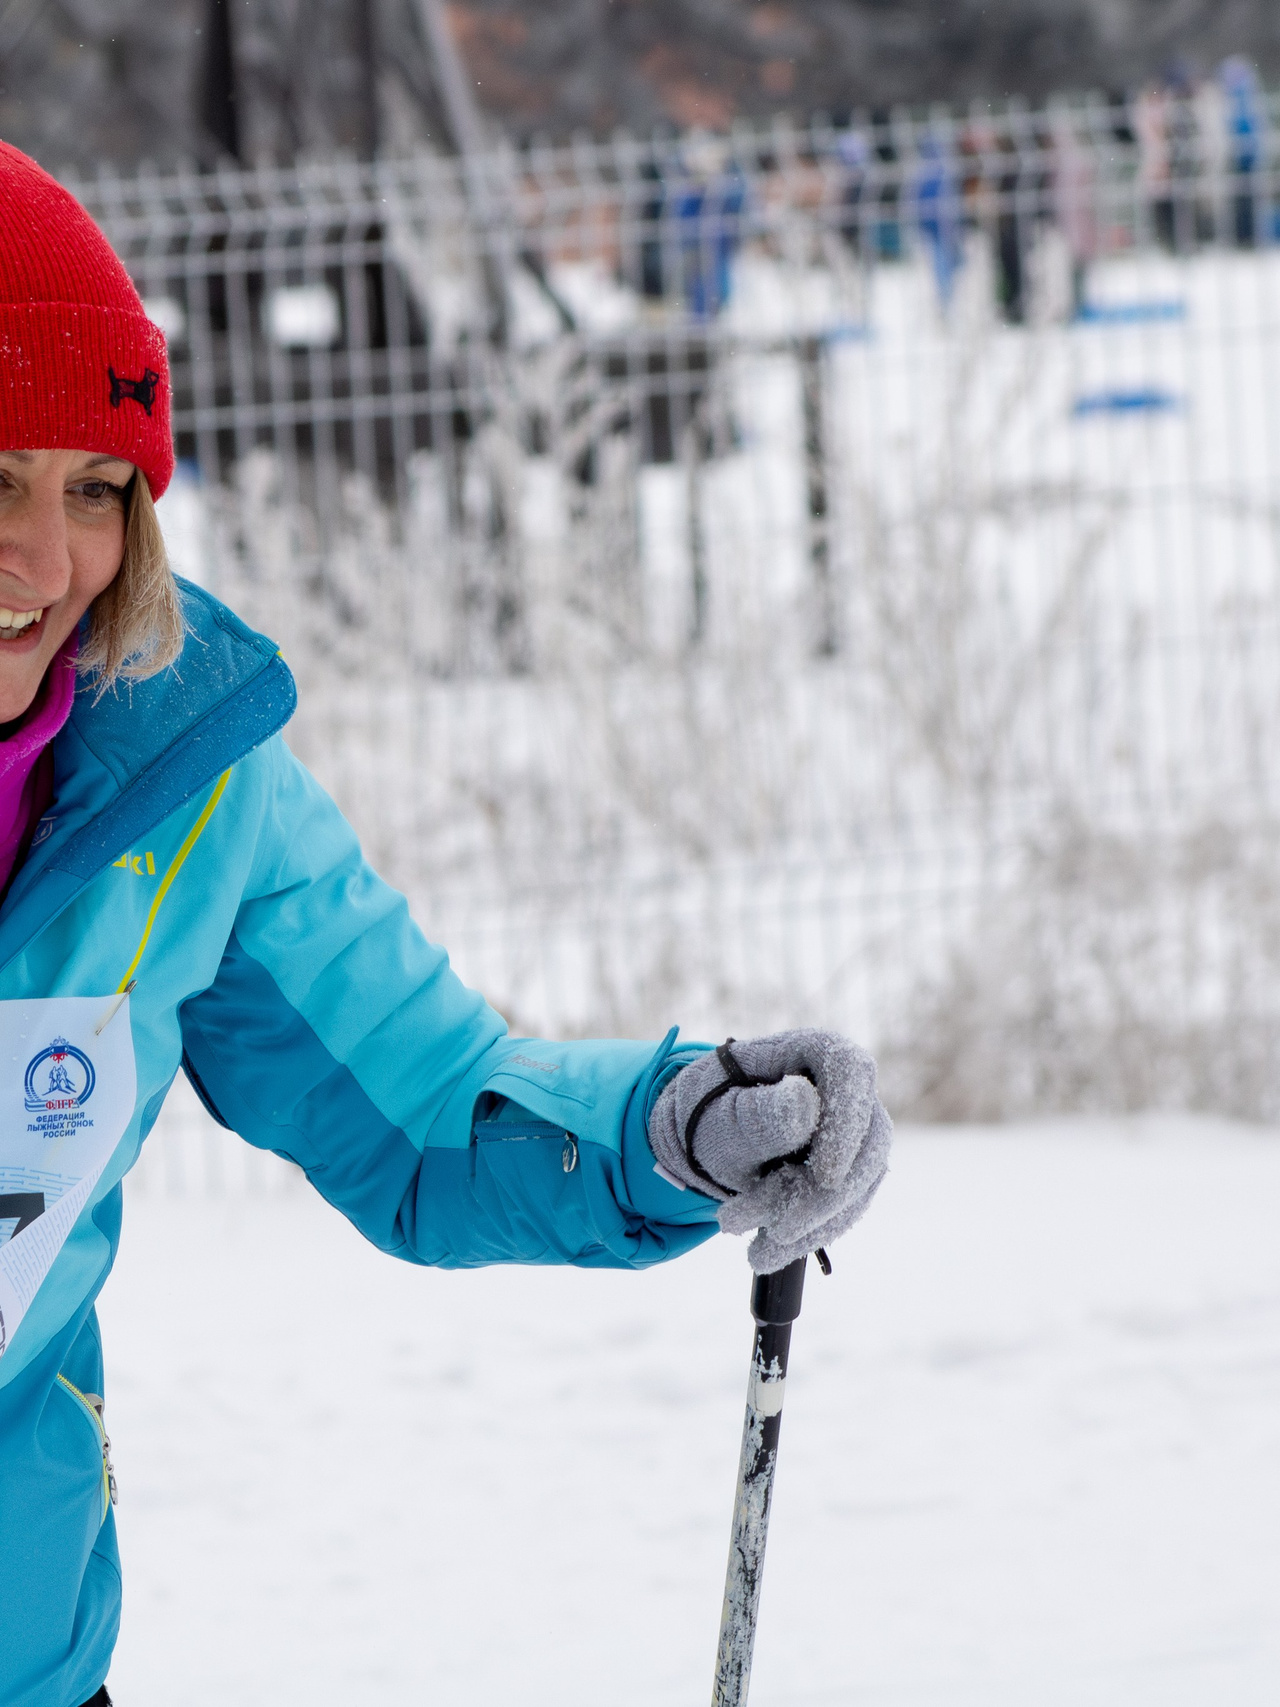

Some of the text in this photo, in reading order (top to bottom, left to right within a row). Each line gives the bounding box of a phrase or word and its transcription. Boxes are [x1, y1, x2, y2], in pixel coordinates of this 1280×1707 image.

[35, 1111, 85, 1123] ФЕДЕРАЦИЯ
[26, 1119, 94, 1132] ЛЫЖНЫХ ГОНОК
[43, 1129, 76, 1139] РОССИИ
